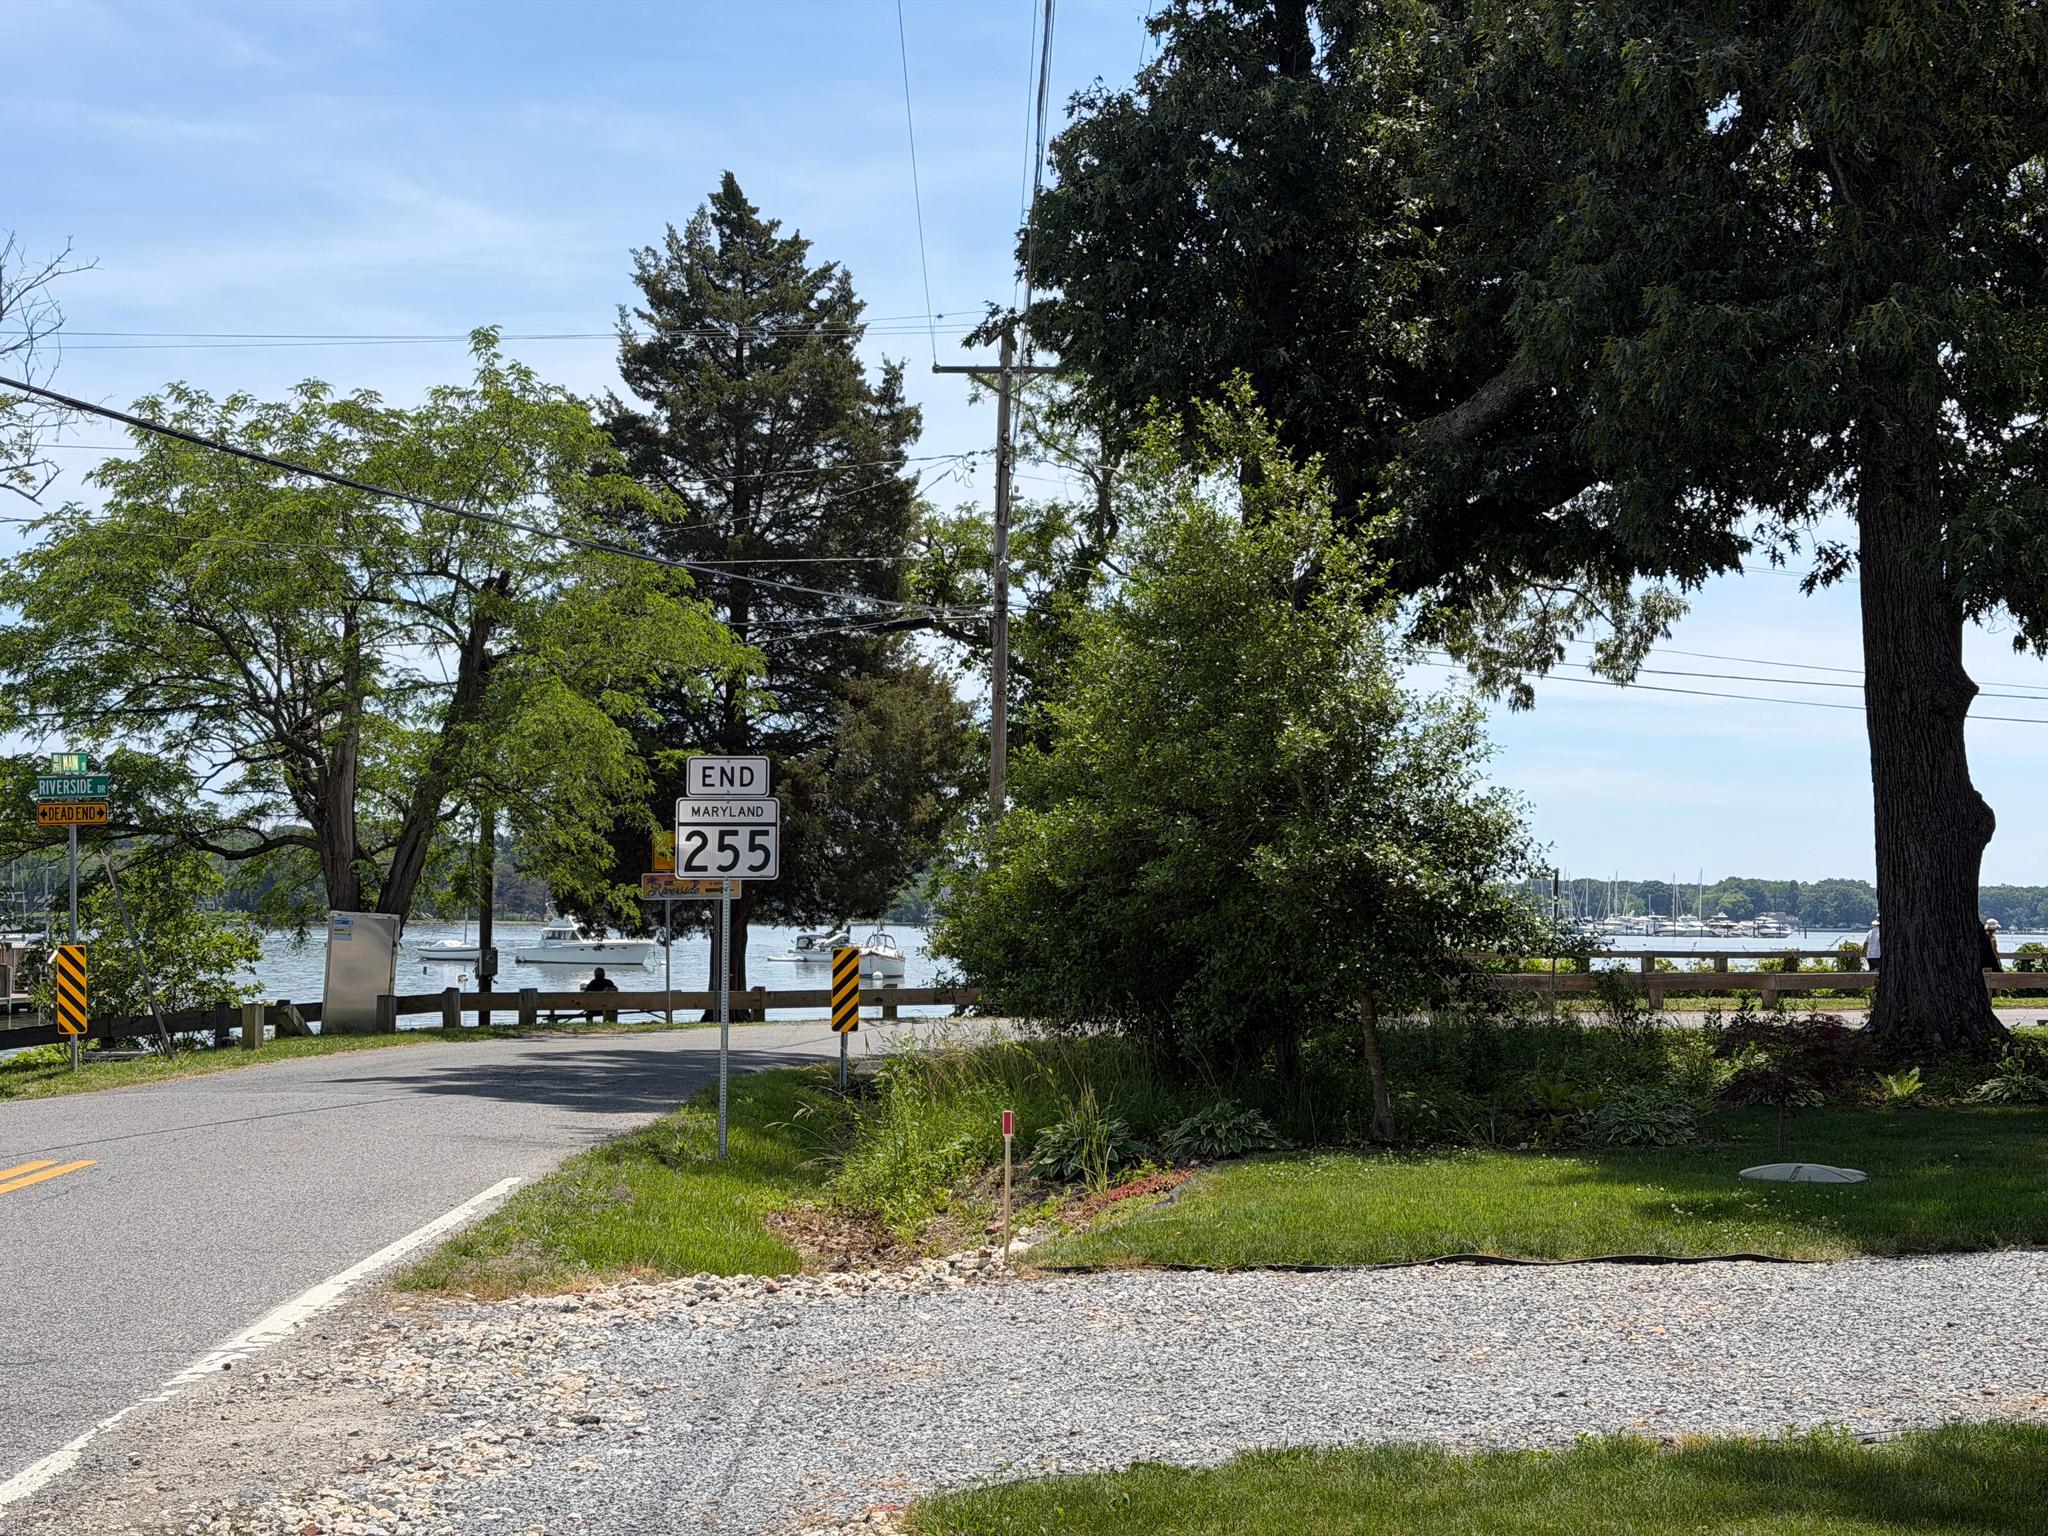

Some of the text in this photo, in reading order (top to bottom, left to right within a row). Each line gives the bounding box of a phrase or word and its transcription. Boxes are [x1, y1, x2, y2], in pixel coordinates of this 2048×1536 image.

[702, 766, 755, 788] END
[39, 778, 106, 795] RIVERSIDE DR
[48, 806, 96, 821] DEAD END
[691, 806, 764, 818] MARYLAND
[684, 829, 771, 873] 255
[647, 882, 700, 897] Riverside
